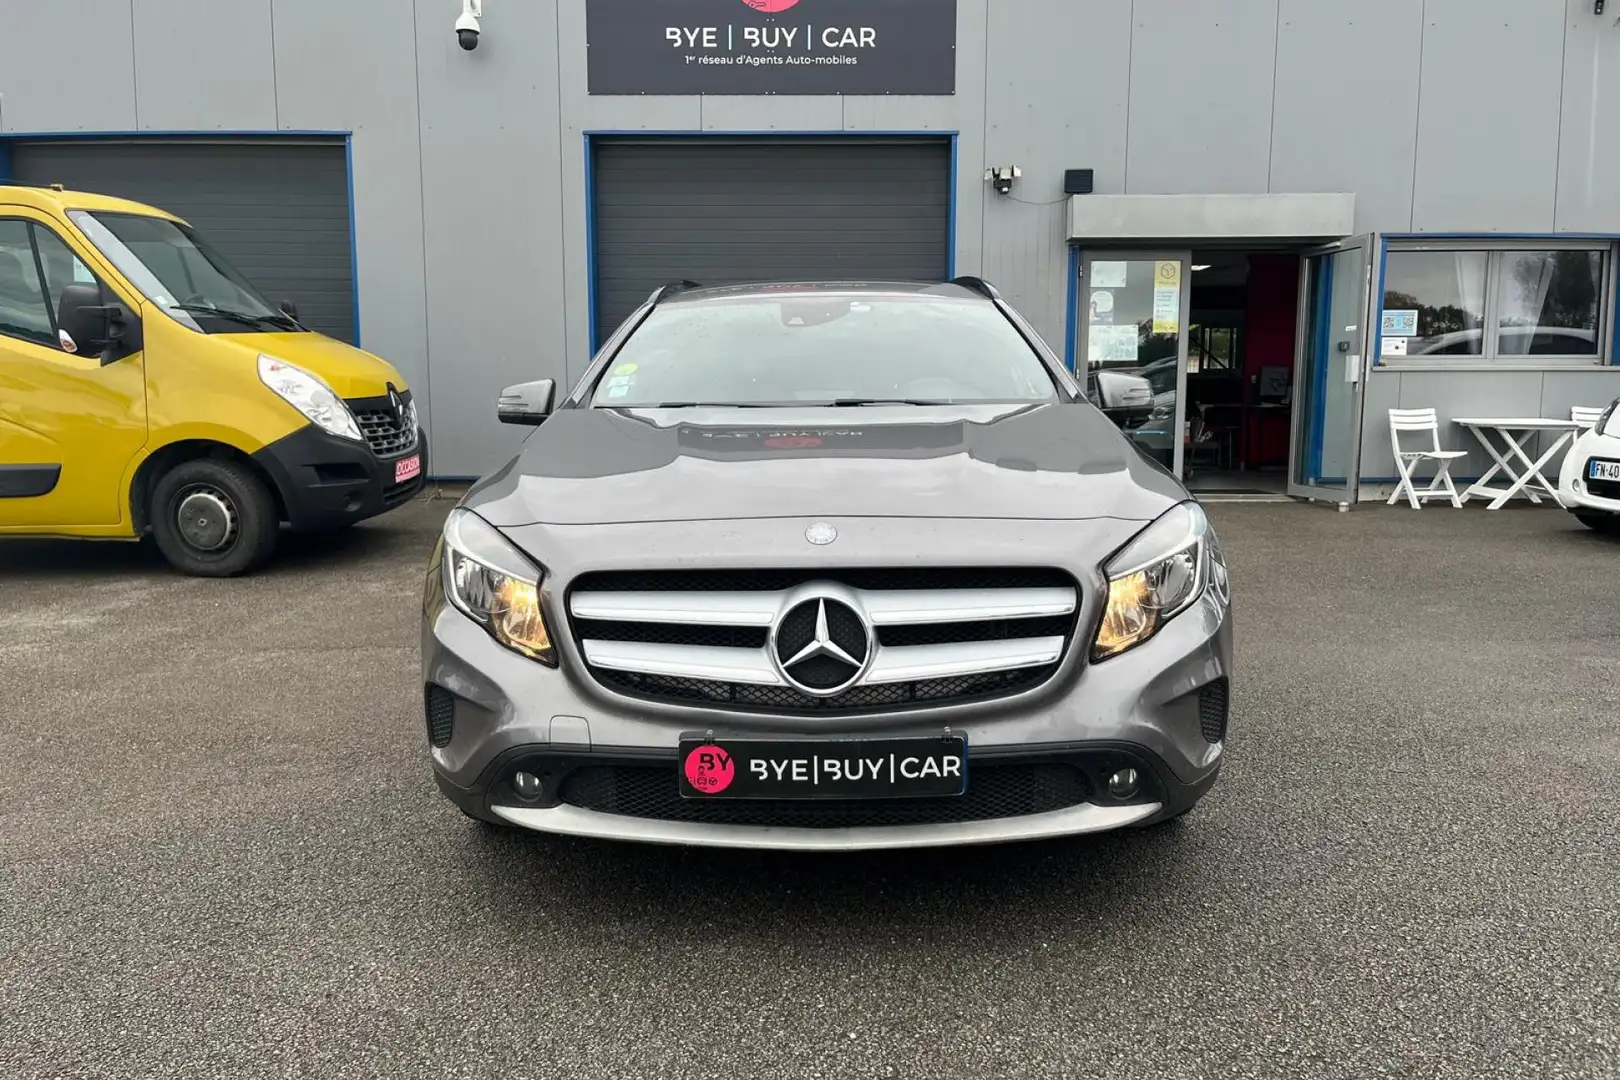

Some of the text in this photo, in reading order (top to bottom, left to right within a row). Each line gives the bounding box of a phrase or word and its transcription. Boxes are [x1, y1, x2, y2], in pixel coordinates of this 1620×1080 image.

[666, 27, 876, 48] BYE BUY CAR
[699, 55, 734, 65] réseau
[786, 55, 858, 65] Auto-mobiles
[700, 752, 730, 771] BY
[900, 756, 961, 779] CAR
